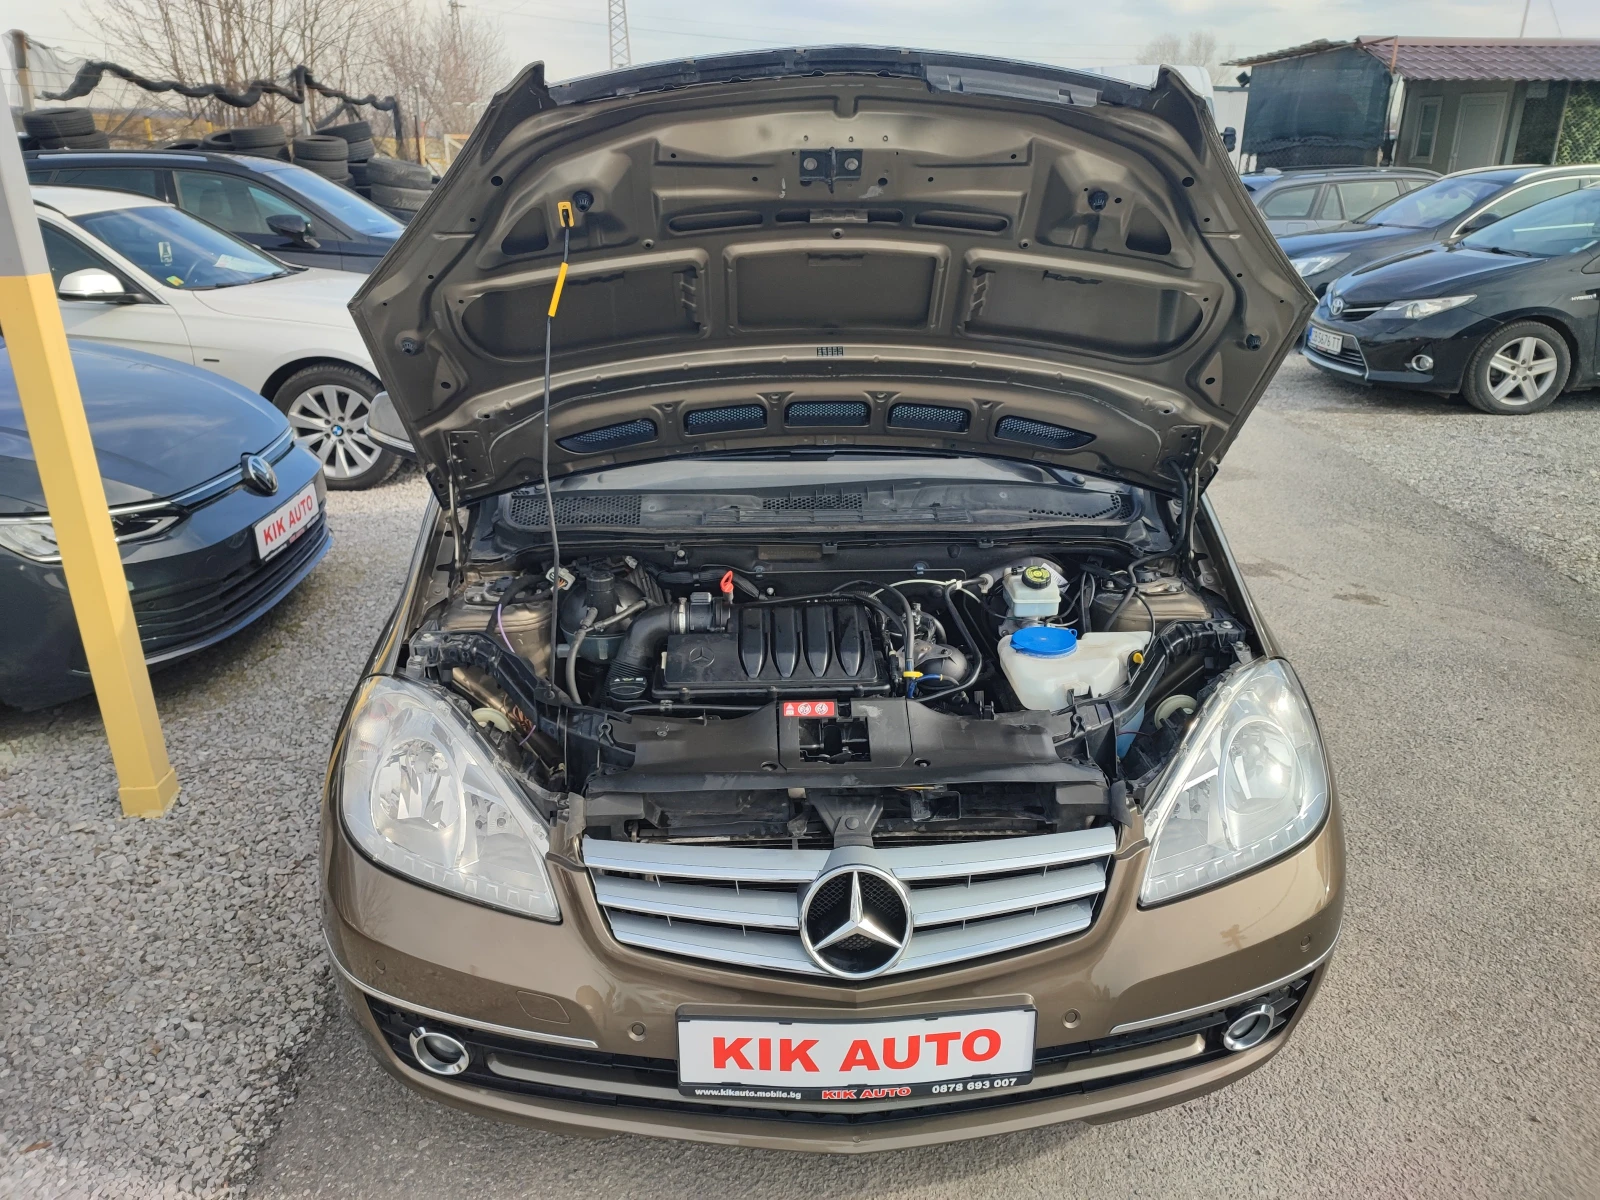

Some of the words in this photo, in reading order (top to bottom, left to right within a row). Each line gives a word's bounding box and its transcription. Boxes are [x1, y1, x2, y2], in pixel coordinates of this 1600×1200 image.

[263, 516, 286, 547] KIK
[289, 495, 313, 529] AUTO
[712, 1036, 821, 1073] KIK
[838, 1028, 1002, 1073] AUTO
[694, 1088, 802, 1100] www.kikauto.mobile.bg
[821, 1089, 858, 1100] KIK
[860, 1086, 912, 1099] AUTO
[931, 1083, 964, 1094] 0878
[966, 1079, 990, 1091] 693
[993, 1077, 1018, 1088] 007
